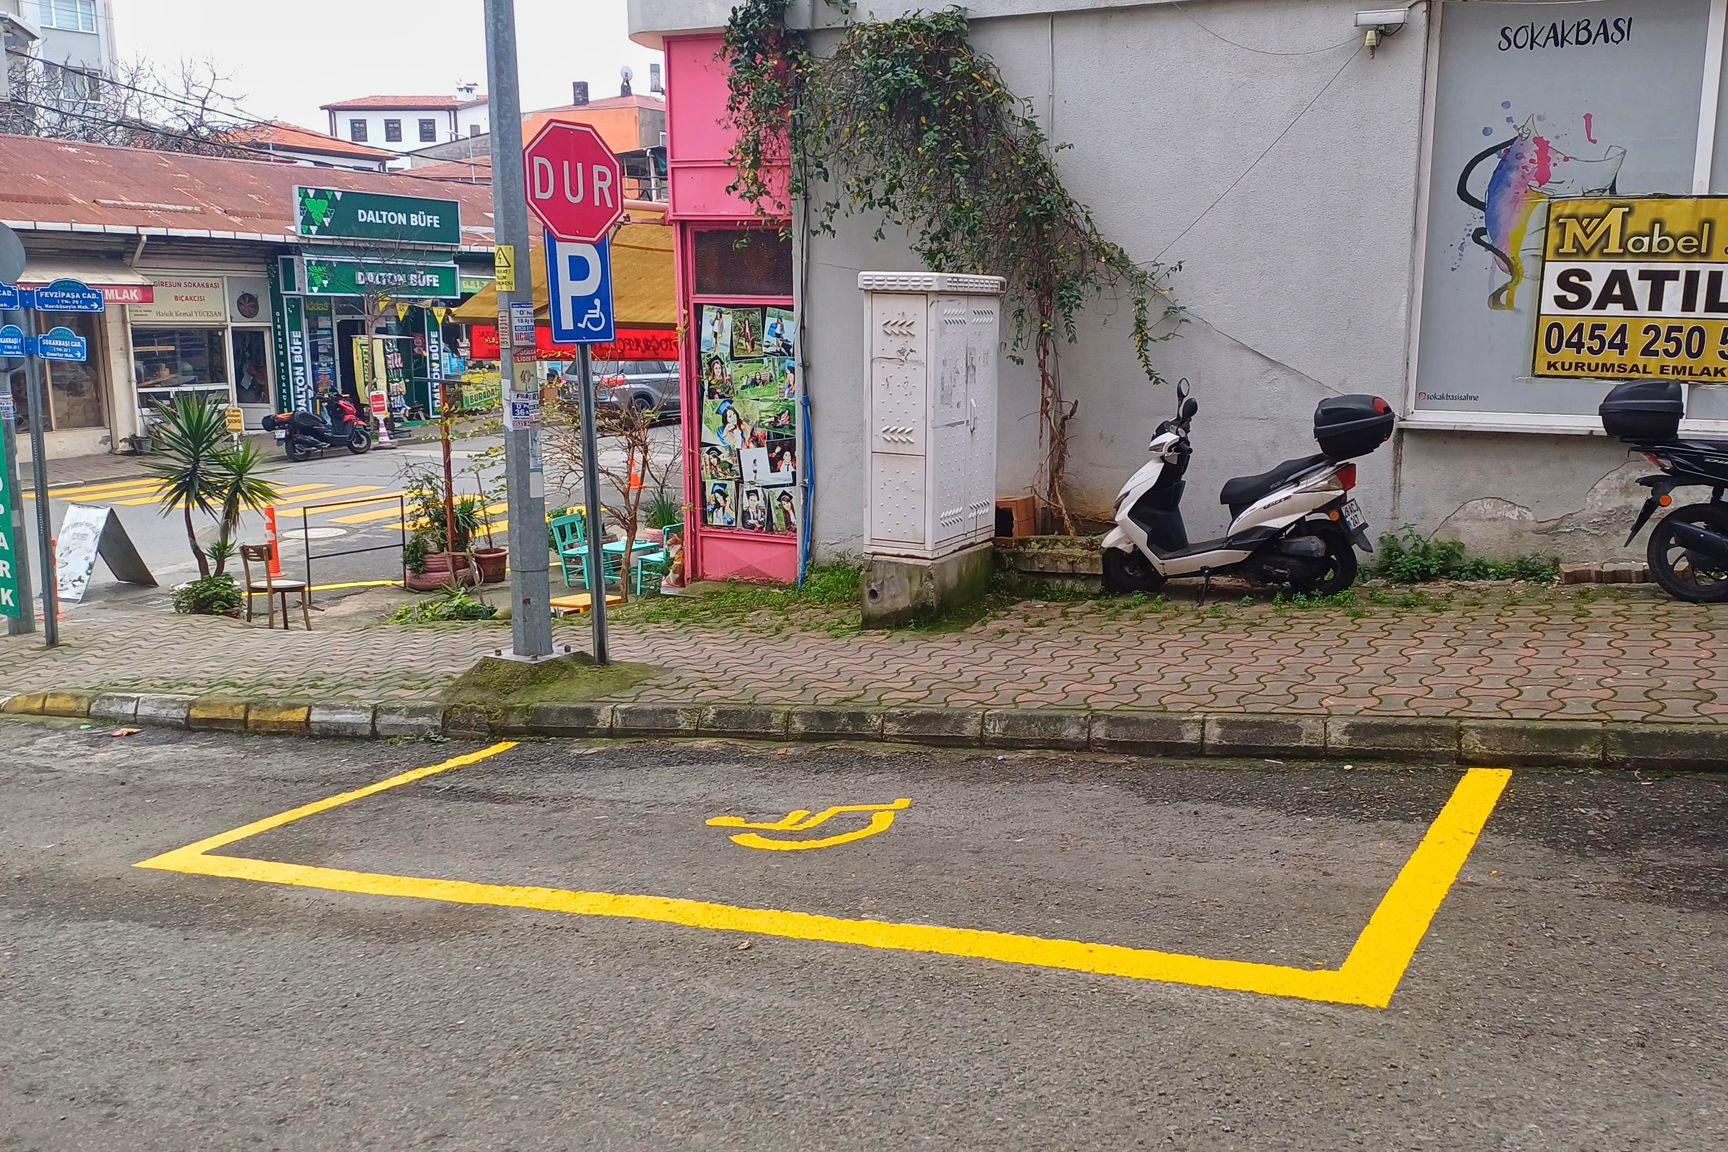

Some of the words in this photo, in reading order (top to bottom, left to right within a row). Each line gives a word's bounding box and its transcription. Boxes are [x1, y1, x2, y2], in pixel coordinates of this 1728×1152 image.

[1498, 17, 1633, 52] SOKAKBAŞI
[533, 156, 613, 208] DUR
[357, 209, 407, 226] DALTON
[410, 210, 440, 228] BÜFE
[1558, 207, 1711, 254] Mabel
[154, 280, 182, 288] GİRESUN
[184, 281, 220, 289] SOKAKBAŞI
[355, 271, 407, 286] DALTON
[409, 270, 440, 287] BÜFE
[555, 241, 602, 330] P
[40, 290, 80, 299] FEVZİPAŞA
[103, 288, 139, 300] MLAK
[290, 330, 304, 363] BÜFE
[1544, 321, 1629, 356] 0454
[1639, 324, 1706, 360] 250
[1546, 360, 1652, 374] KURUMSAL
[1659, 364, 1728, 378] EMLAK
